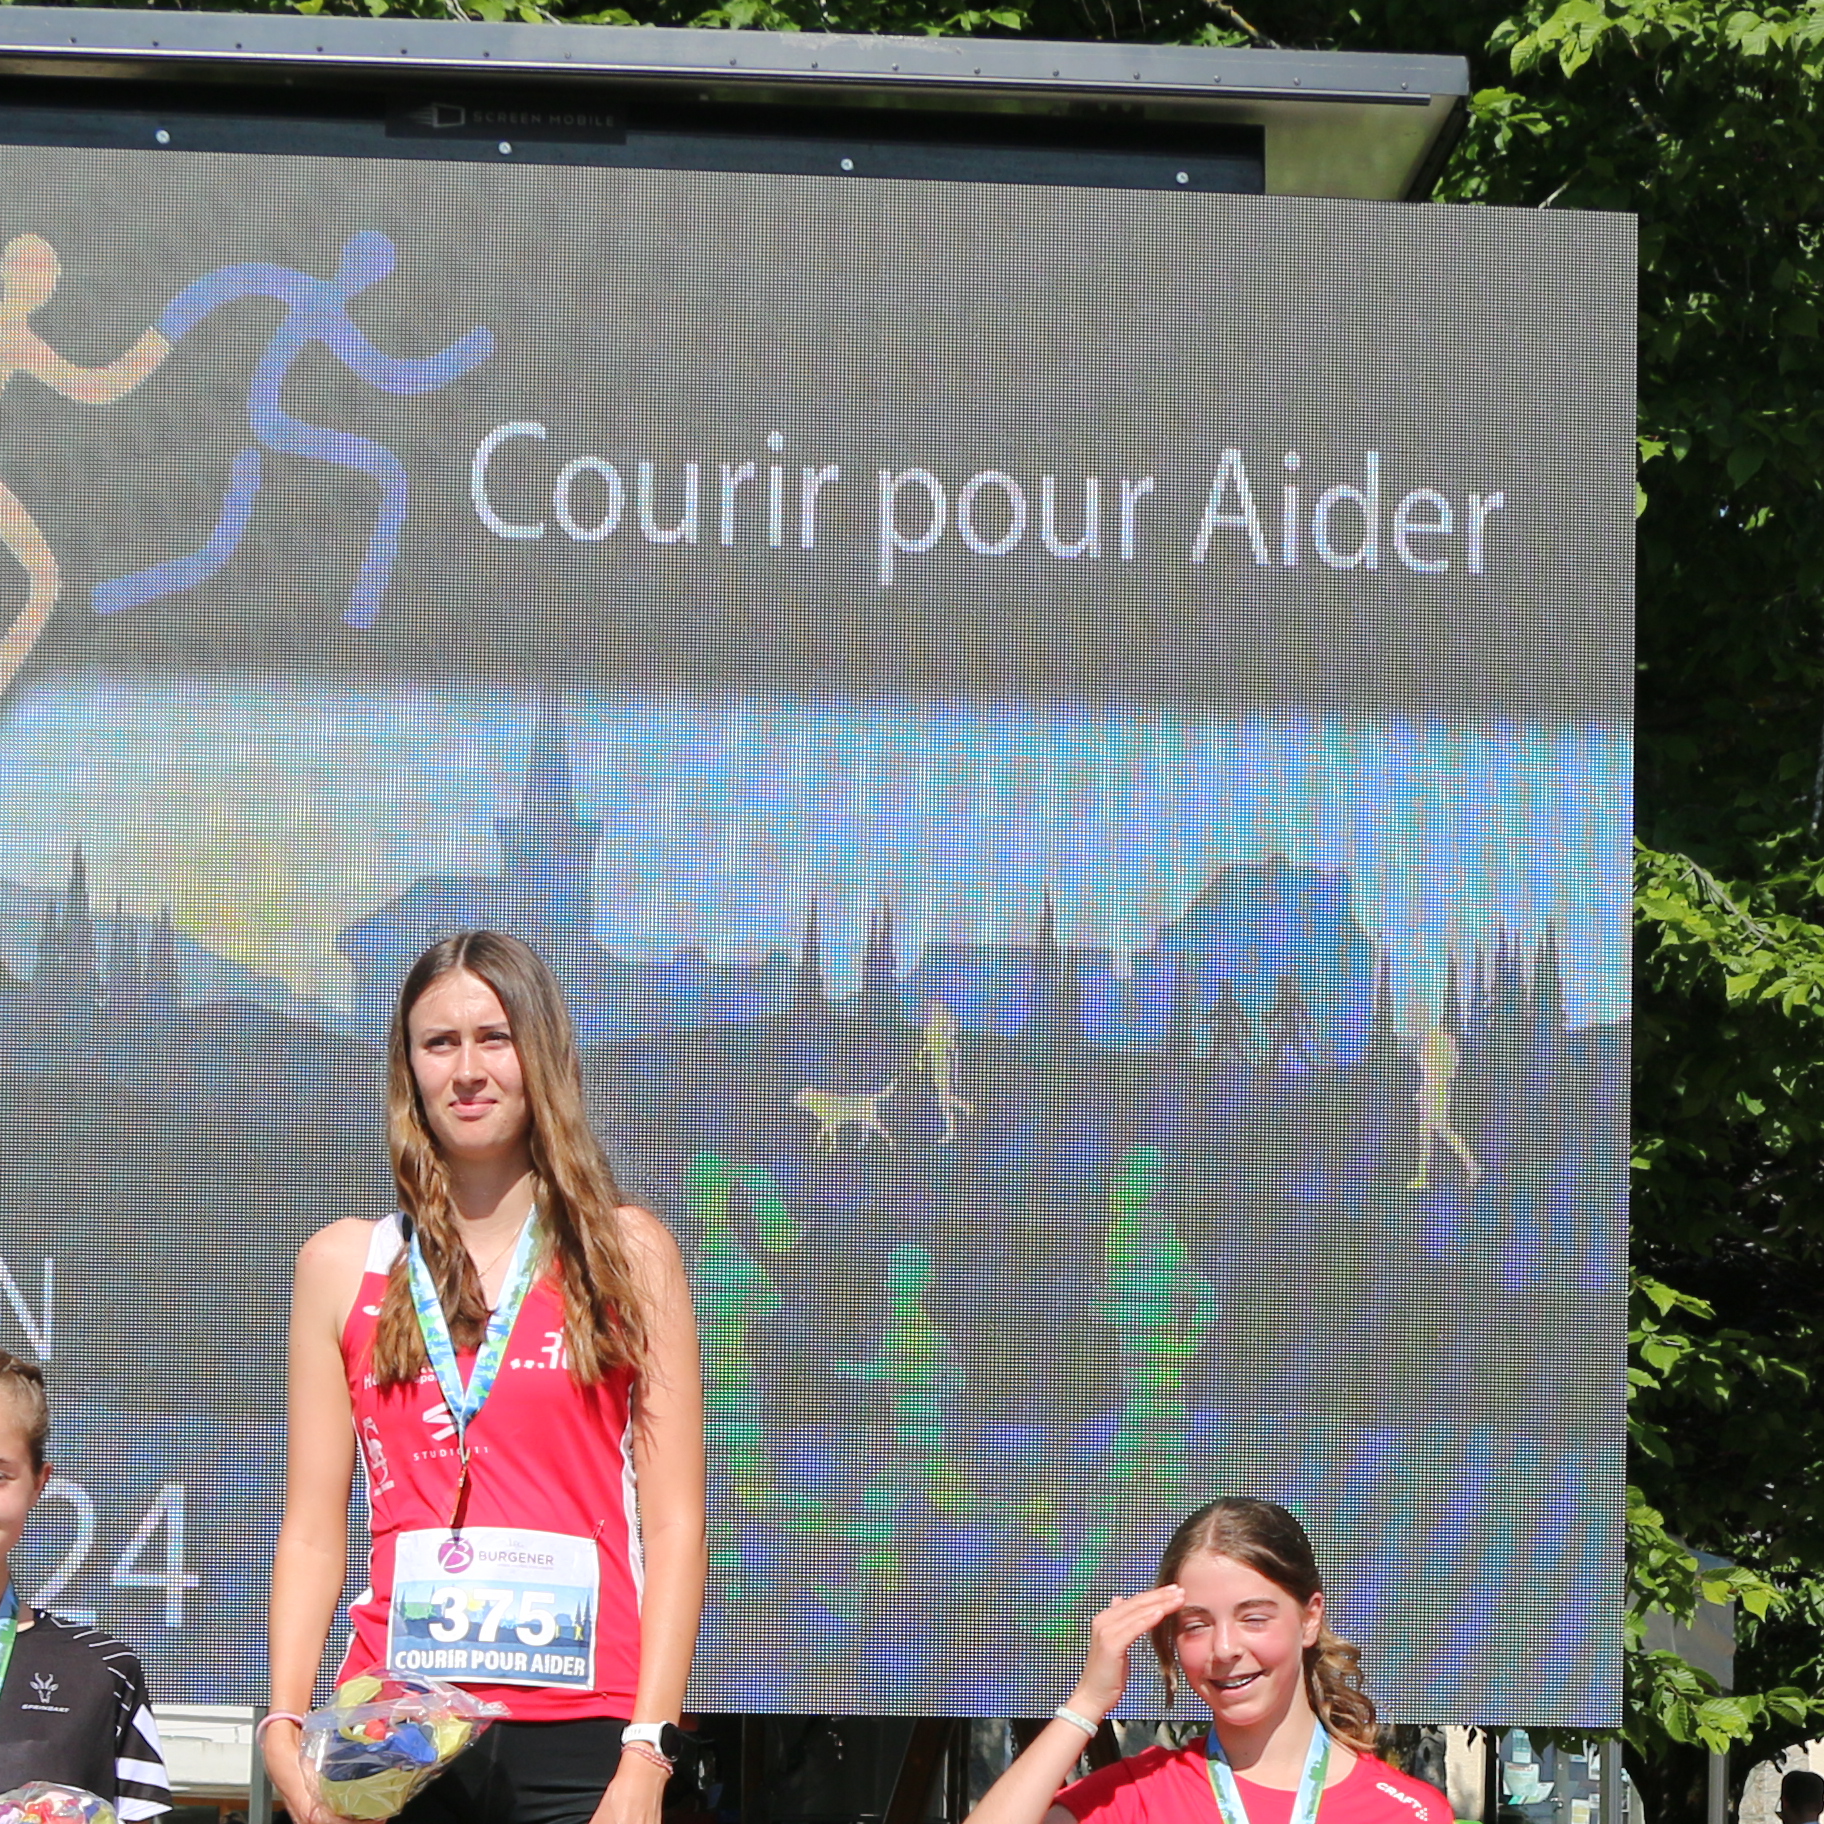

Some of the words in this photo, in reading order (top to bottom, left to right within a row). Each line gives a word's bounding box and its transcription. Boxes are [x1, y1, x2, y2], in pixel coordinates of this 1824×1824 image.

[472, 110, 542, 125] SCREEN
[549, 113, 615, 128] MOBILE
[469, 420, 840, 549] Courir
[879, 463, 1154, 587] pour
[1192, 446, 1506, 577] Aider
[478, 1549, 555, 1566] BURGENER
[428, 1586, 557, 1647] 375
[394, 1647, 468, 1670] COURIR
[470, 1650, 528, 1672] POUR
[530, 1653, 587, 1677] AIDER
[1375, 1781, 1422, 1813] CRAFT
